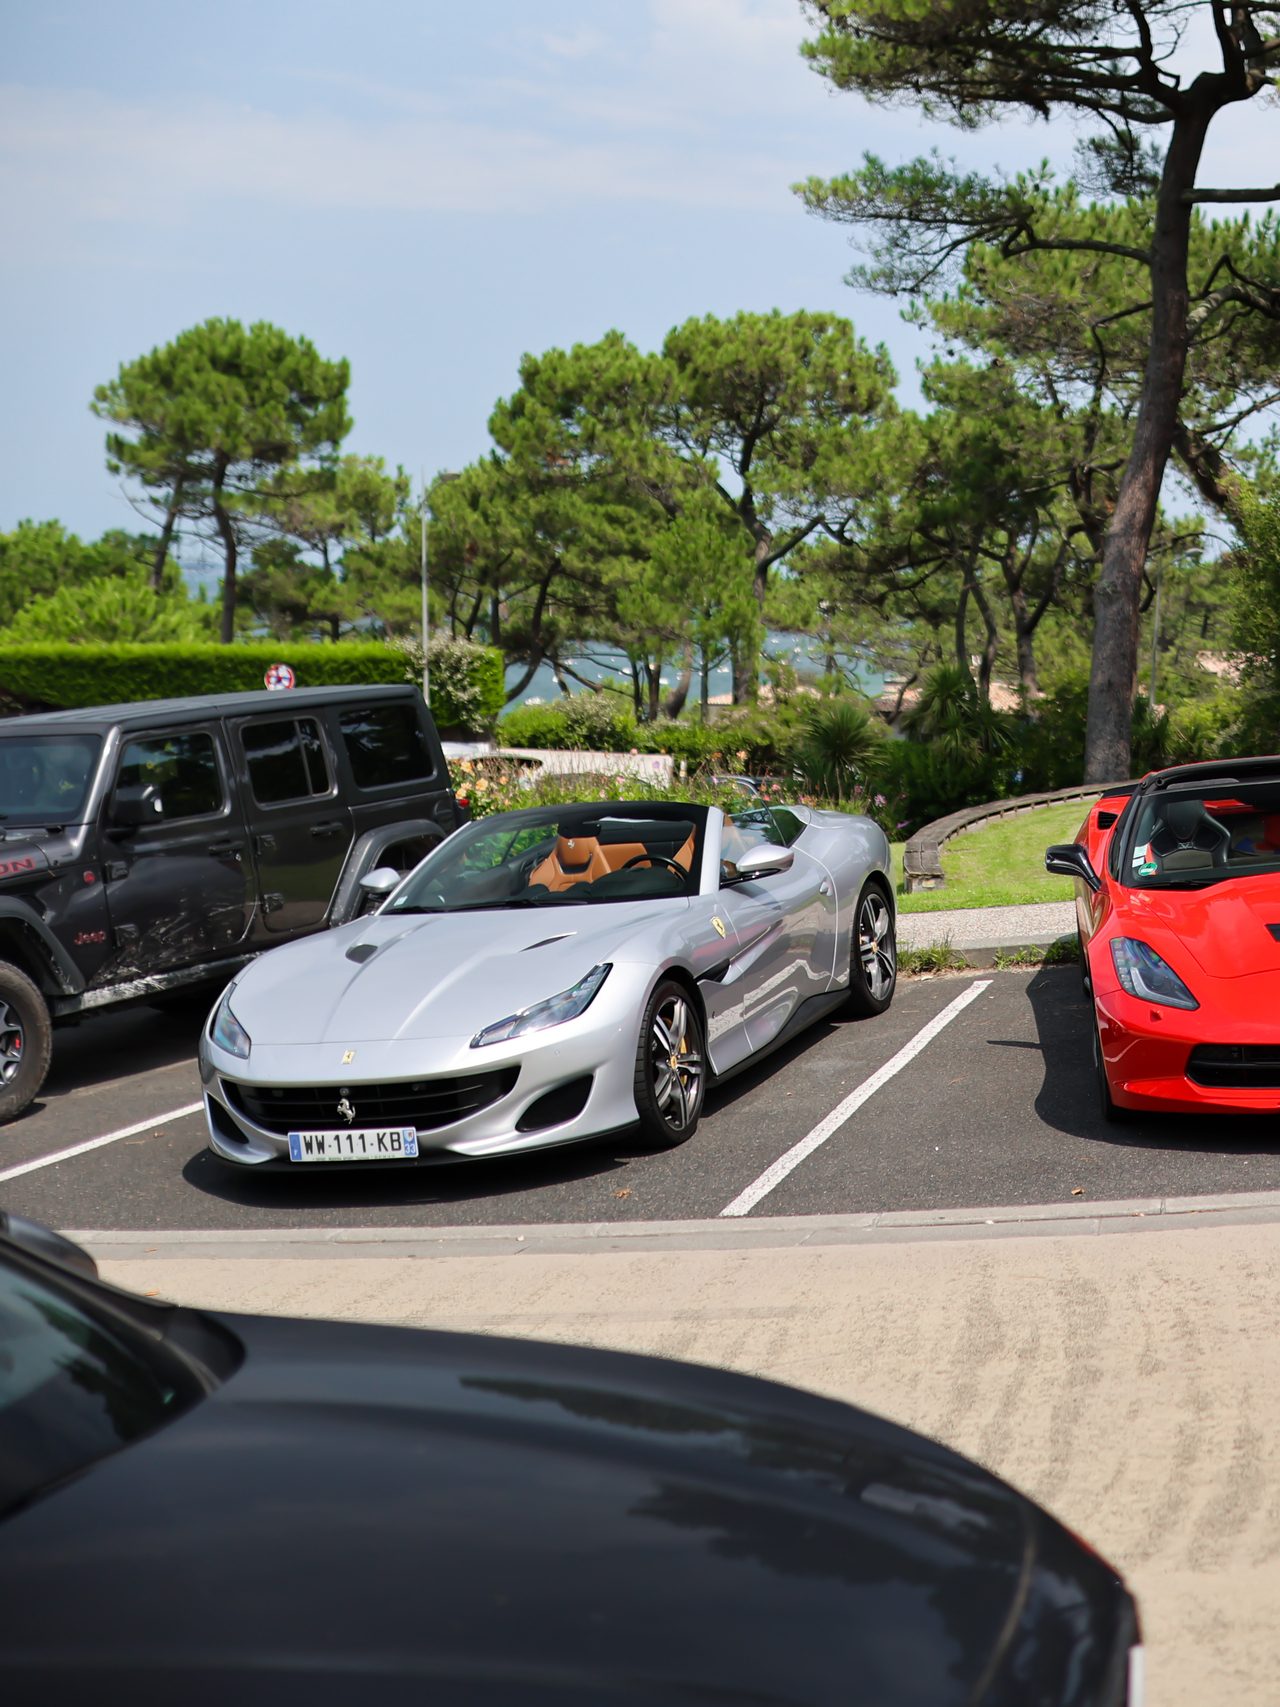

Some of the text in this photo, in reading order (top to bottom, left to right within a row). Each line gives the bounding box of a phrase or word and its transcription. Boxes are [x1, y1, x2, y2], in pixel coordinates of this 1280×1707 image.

[73, 930, 106, 946] Jeep
[302, 1132, 402, 1155] WW-111-KB
[404, 1143, 416, 1155] 33
